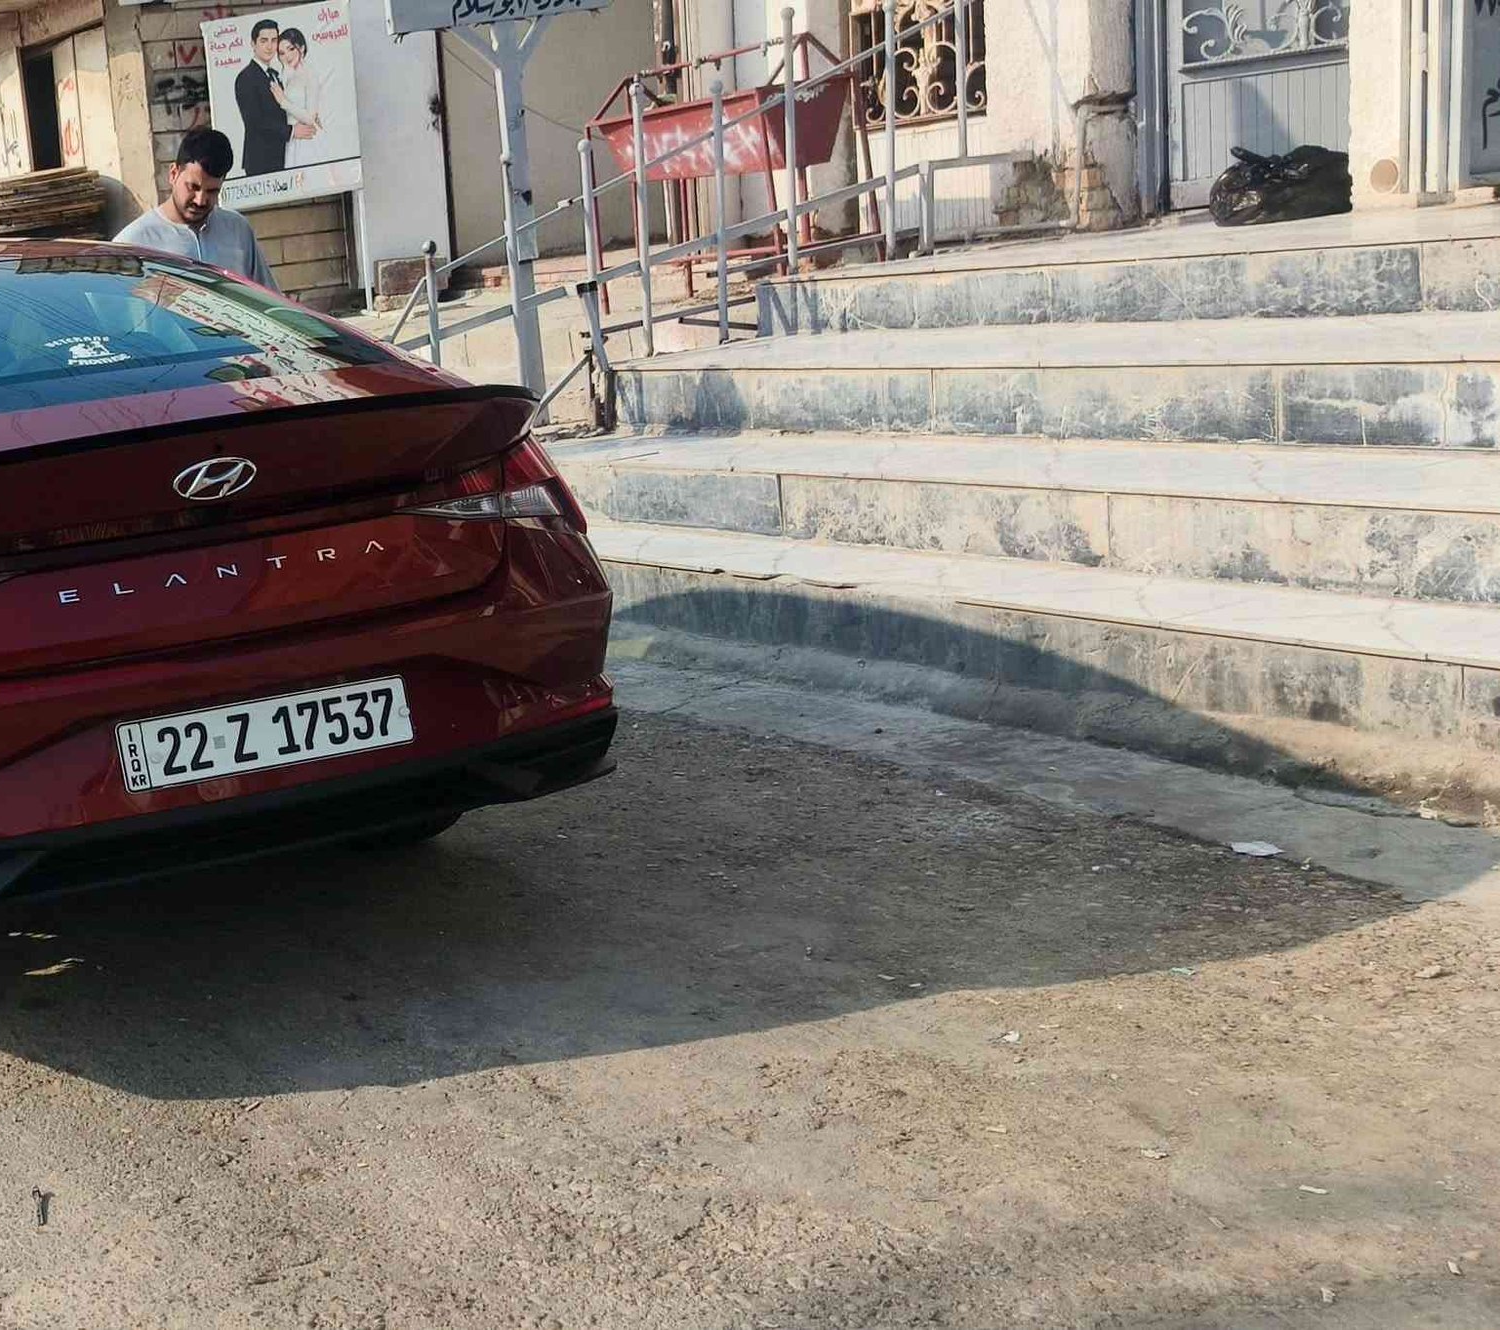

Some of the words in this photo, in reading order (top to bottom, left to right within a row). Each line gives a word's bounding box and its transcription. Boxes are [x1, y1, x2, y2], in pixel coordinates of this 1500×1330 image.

[57, 539, 385, 604] ELANTRA
[157, 722, 214, 776] 22
[227, 712, 258, 763] Z
[272, 687, 394, 755] 17537
[131, 774, 147, 787] KR
